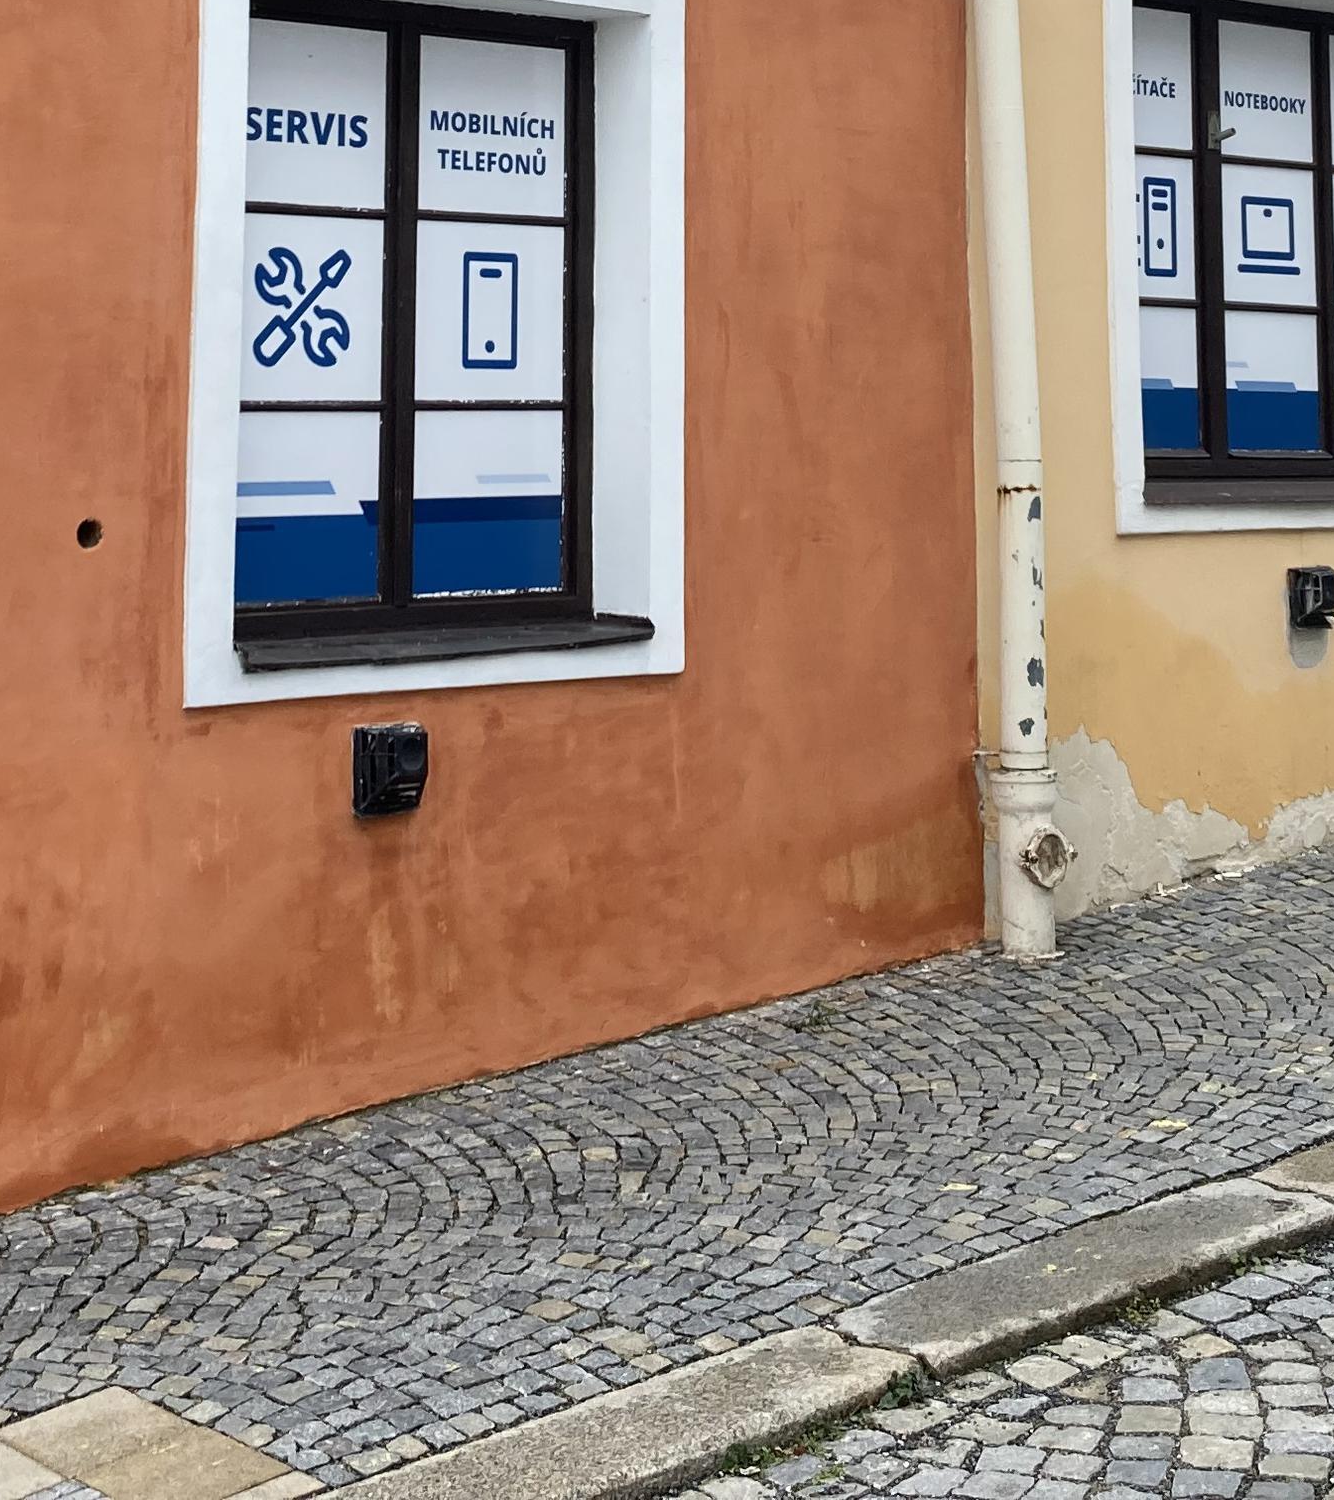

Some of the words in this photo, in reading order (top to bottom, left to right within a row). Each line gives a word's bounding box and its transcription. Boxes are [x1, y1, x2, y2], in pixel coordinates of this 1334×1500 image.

[1133, 73, 1175, 99] ÍTAČE
[1224, 90, 1306, 115] NOTEBOOKY
[246, 107, 369, 148] SERVIS
[430, 110, 555, 140] MOBILNÍCH
[437, 147, 547, 176] TELEFONŮ
